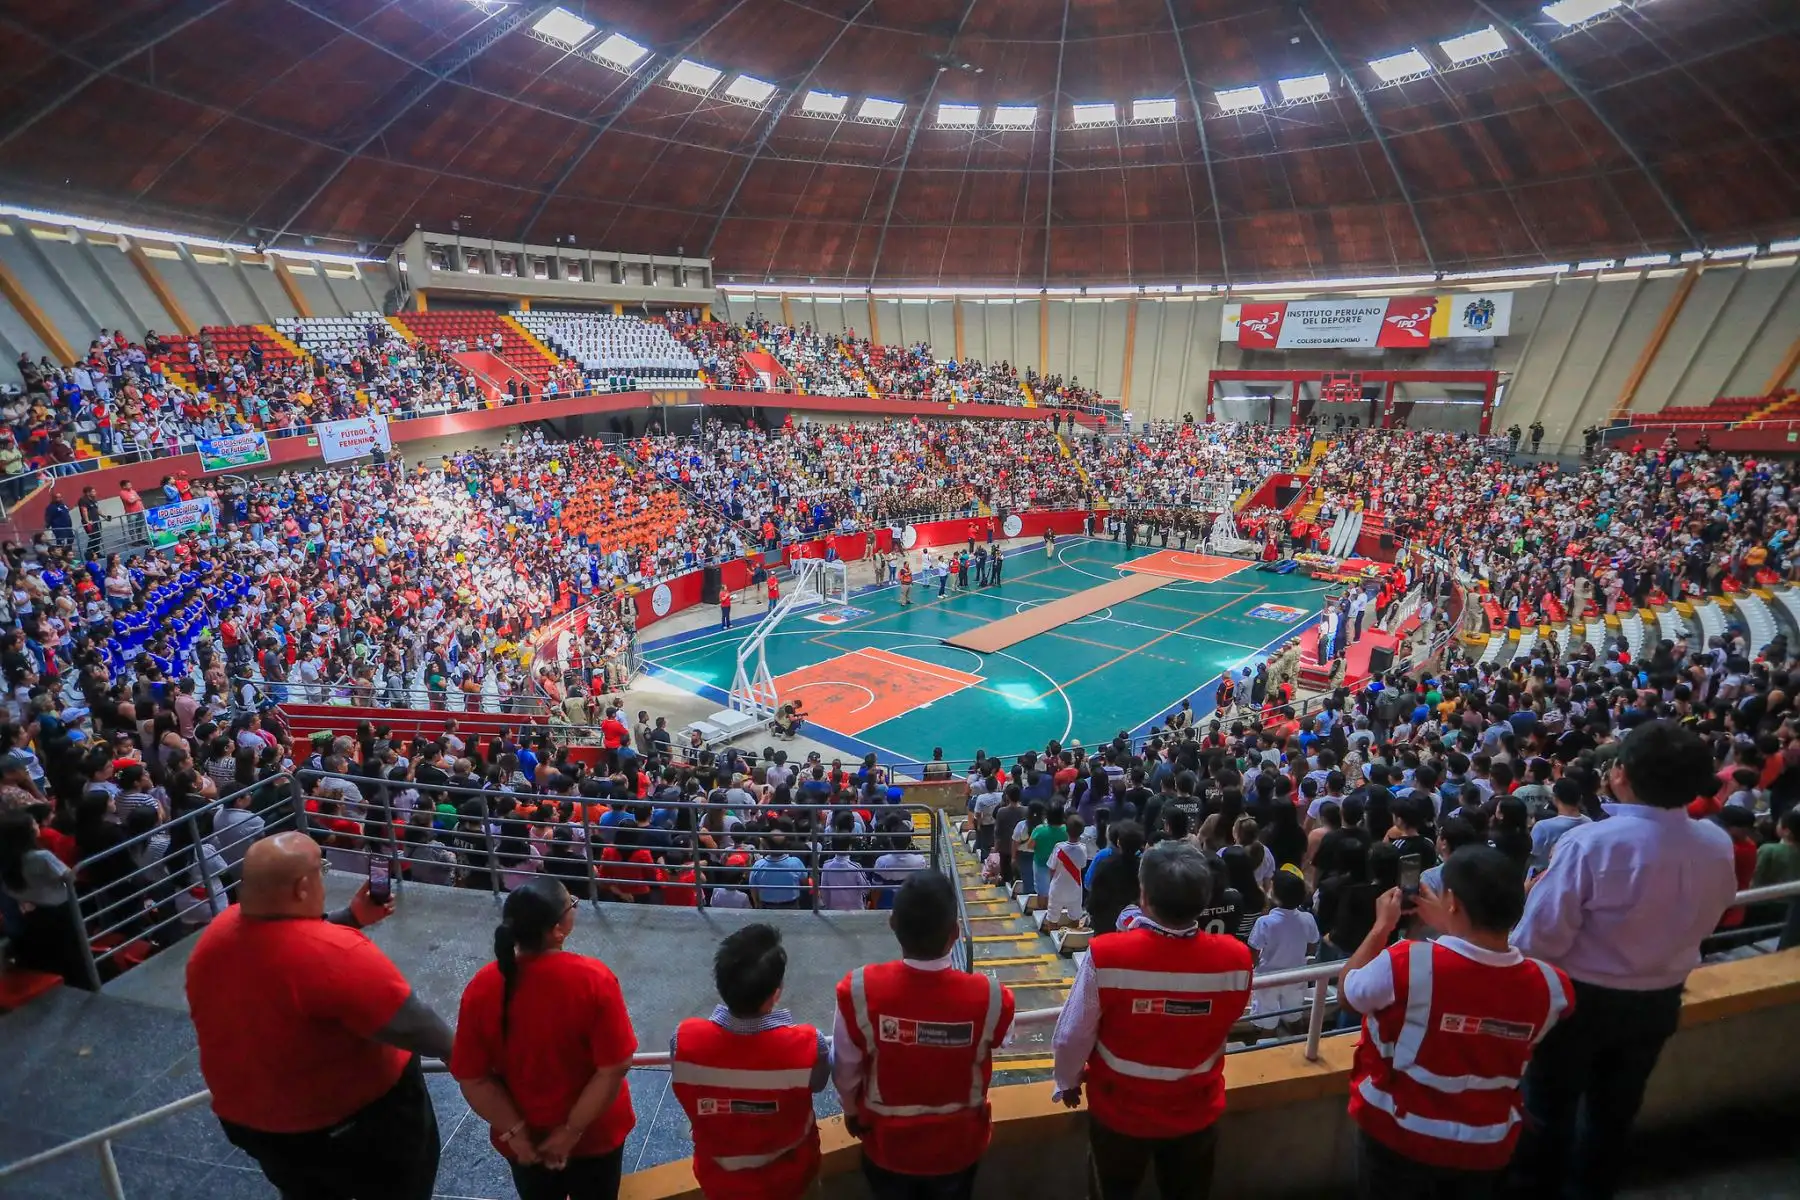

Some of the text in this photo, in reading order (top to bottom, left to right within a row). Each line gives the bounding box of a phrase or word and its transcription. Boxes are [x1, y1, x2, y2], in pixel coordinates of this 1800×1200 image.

[1287, 307, 1381, 318] INSTITUTO PERUANO
[1302, 316, 1362, 325] DEL DEPORTE
[1397, 320, 1417, 328] IPD
[1250, 323, 1267, 331] IPD
